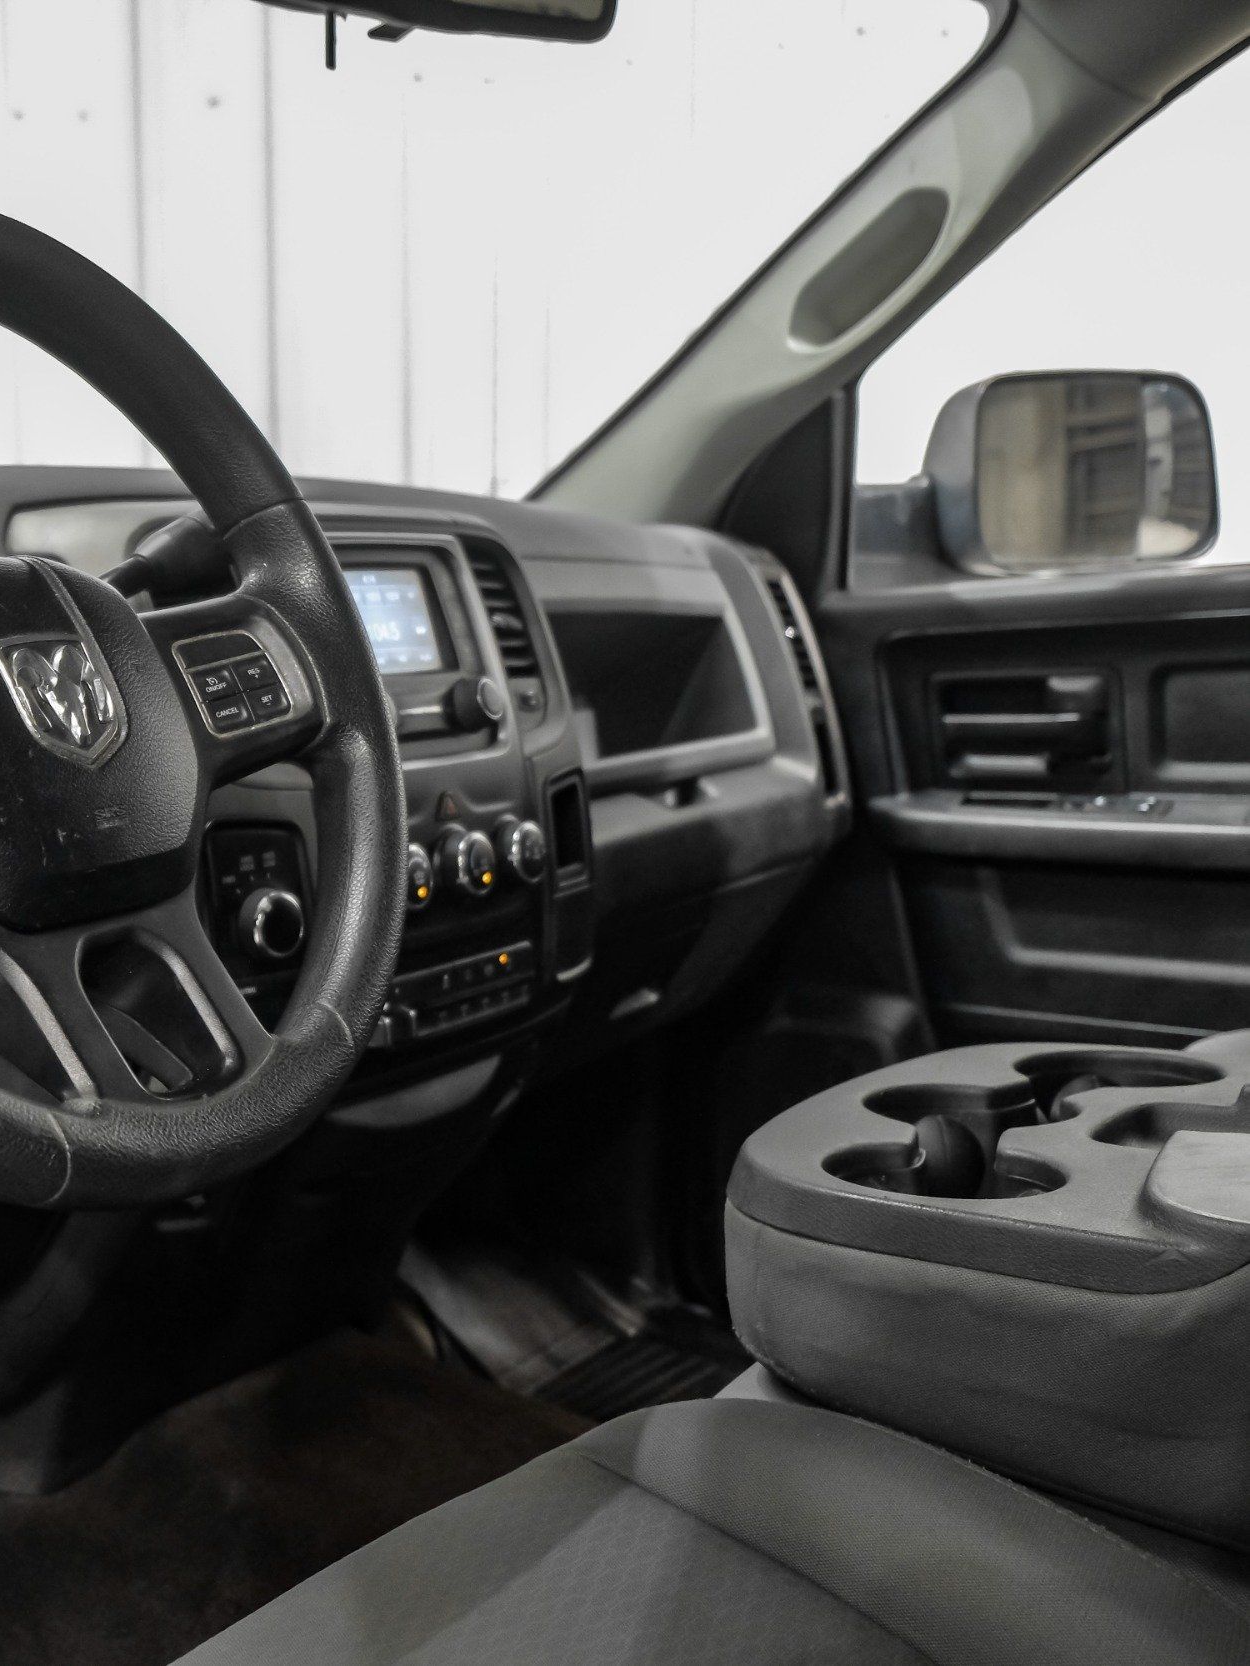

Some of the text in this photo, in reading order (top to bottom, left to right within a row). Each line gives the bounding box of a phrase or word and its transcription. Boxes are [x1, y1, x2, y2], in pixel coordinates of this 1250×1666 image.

[248, 668, 260, 676] RES
[261, 694, 272, 703] SET
[215, 707, 239, 718] CANCEL
